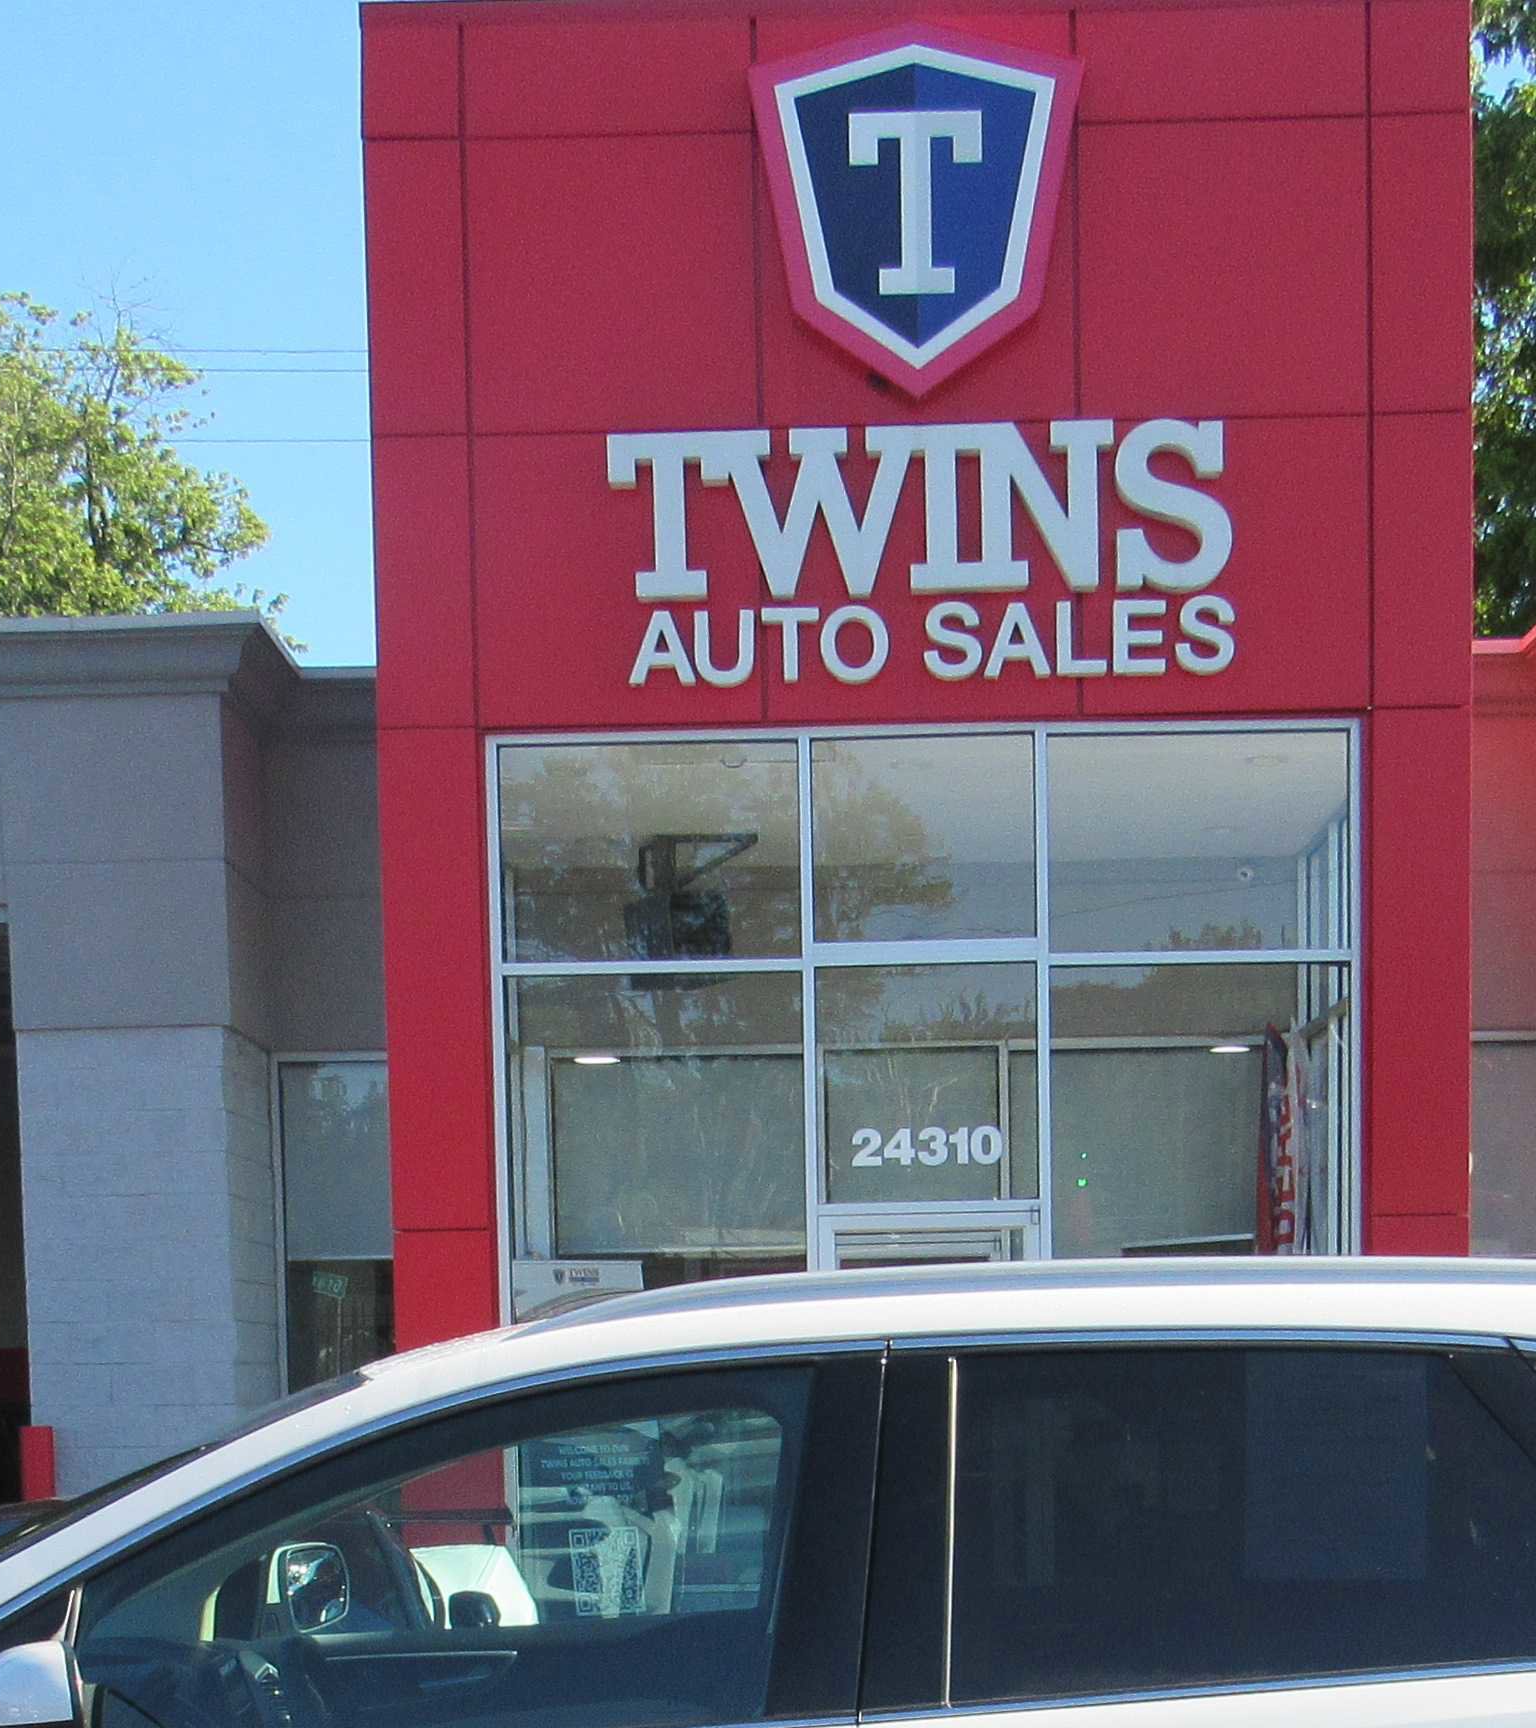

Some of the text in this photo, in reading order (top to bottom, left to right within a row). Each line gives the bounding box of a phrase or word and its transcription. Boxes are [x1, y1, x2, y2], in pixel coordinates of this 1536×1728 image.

[848, 110, 983, 295] T
[606, 419, 1234, 600] TWINS
[629, 595, 1236, 687] AUTO SALES
[851, 1126, 1004, 1169] 24310
